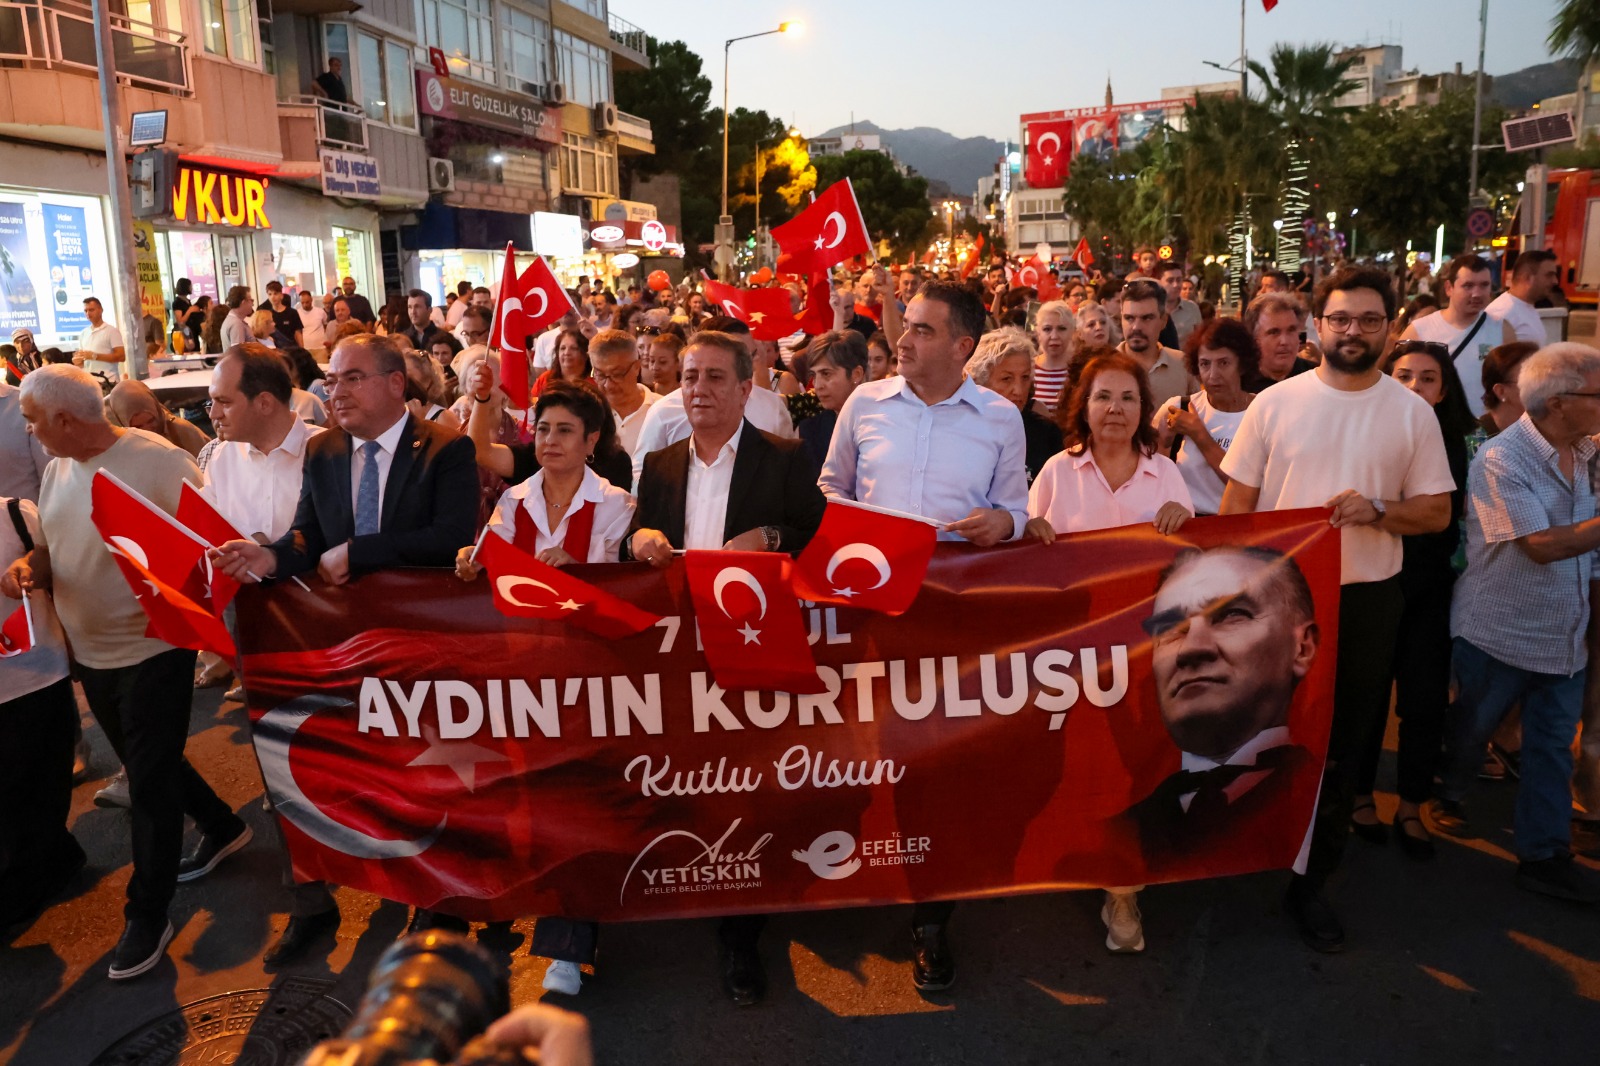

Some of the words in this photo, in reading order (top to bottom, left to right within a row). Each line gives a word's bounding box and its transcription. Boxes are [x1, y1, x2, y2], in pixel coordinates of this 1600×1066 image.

[450, 87, 470, 107] ELİT
[472, 92, 520, 120] GÜZELLİK
[1064, 107, 1107, 118] MHP
[335, 156, 350, 178] DİŞ
[351, 159, 378, 179] HEKİMİ
[61, 237, 82, 246] BEYAZ
[63, 245, 83, 256] EŞYA
[655, 615, 682, 653] 7
[357, 672, 664, 740] AYDIN'IN
[690, 644, 1130, 733] KURTULUŞU
[624, 754, 763, 797] Kutlu
[773, 744, 906, 790] Olsun
[862, 836, 932, 856] EFELER
[869, 852, 925, 867] BELEDİYESİ
[641, 862, 761, 885] YETİŞKİN
[644, 886, 677, 895] EFELER
[679, 883, 722, 893] BELEDİYE
[724, 881, 762, 891] BAŞKANI
